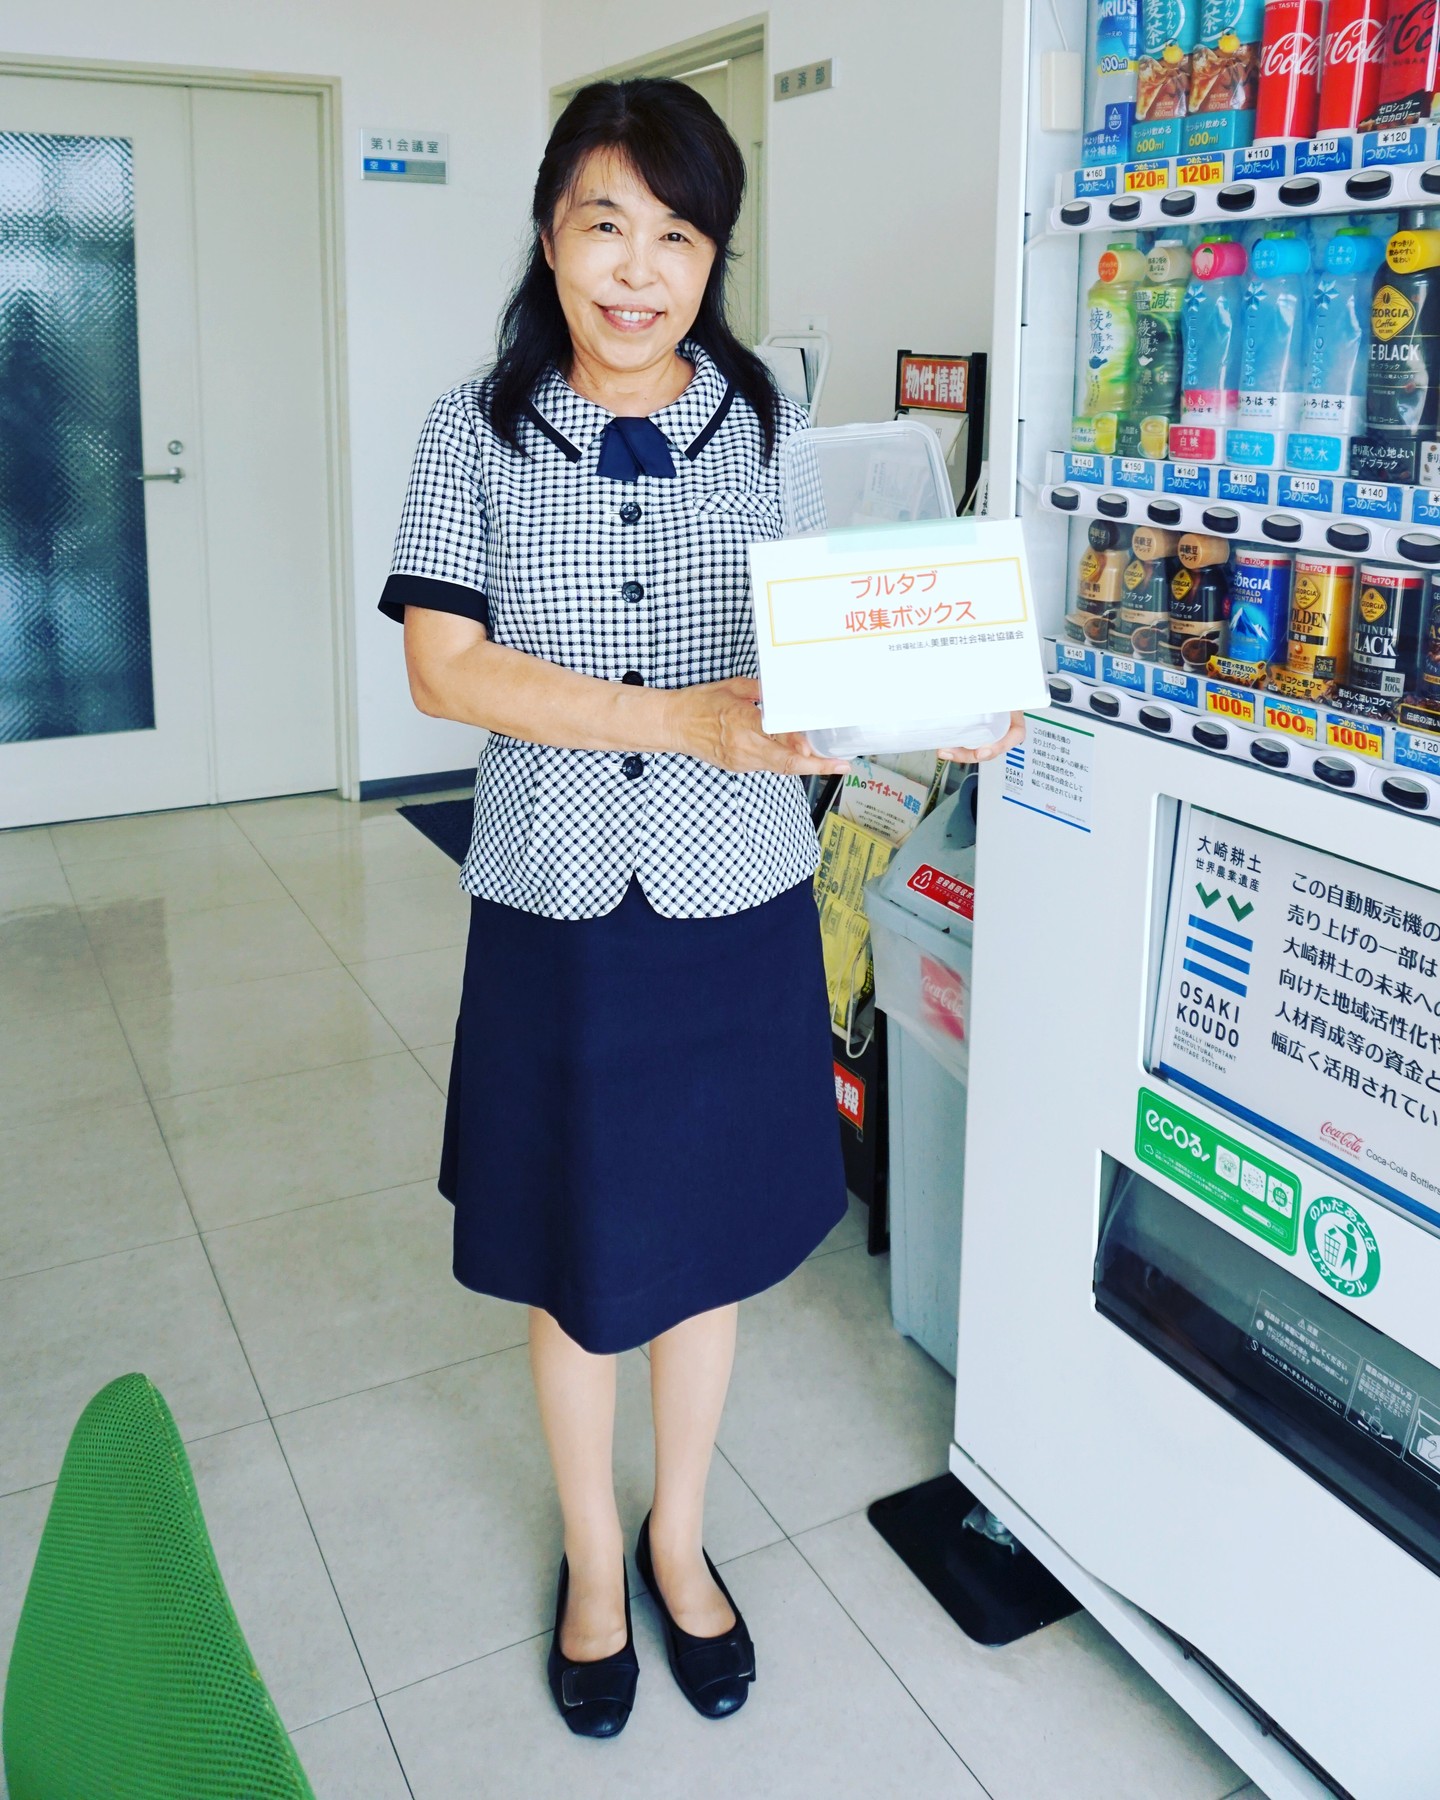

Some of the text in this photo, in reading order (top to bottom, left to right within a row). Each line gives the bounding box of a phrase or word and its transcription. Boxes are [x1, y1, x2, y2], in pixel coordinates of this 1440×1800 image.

[370, 137, 439, 154] 第1会議室
[1136, 138, 1165, 153] 600ml
[1188, 131, 1219, 147] 600ml
[1382, 132, 1407, 142] ¥120
[1247, 150, 1270, 159] ¥110
[1312, 141, 1335, 152] ¥110
[1085, 169, 1103, 178] ¥160
[1128, 170, 1165, 189] 120円
[1180, 163, 1220, 184] 120円
[1090, 307, 1105, 355] 綾鷹
[1379, 343, 1421, 361] BLACK
[904, 364, 966, 404] 物件情報
[1180, 436, 1199, 448] 白桃
[1230, 440, 1264, 457] 天然水
[1074, 457, 1092, 467] ¥140
[1292, 444, 1329, 462] 天然水
[1124, 462, 1142, 472] ¥150
[1176, 467, 1196, 476] ¥140
[1233, 473, 1254, 483] ¥110
[1294, 480, 1316, 490] ¥110
[1360, 487, 1384, 498] ¥140
[849, 569, 940, 599] プルタブ
[1172, 601, 1202, 613] ブラック
[844, 600, 977, 633] 収集ボックス
[1066, 649, 1083, 658] ¥140
[1115, 661, 1132, 671] ¥130
[1209, 693, 1252, 719] 100円
[1267, 708, 1314, 736] 100円
[1330, 725, 1379, 753] 100円
[1414, 739, 1439, 753] ¥120
[1005, 767, 1024, 779] OSAKI
[1005, 775, 1024, 787] KOUDO
[1197, 835, 1262, 874] 大崎耕土
[1195, 857, 1260, 893] 世界農業遺産
[1292, 872, 1440, 942] この自動販売機の
[1287, 904, 1438, 978] 売り上げの一部は
[1180, 980, 1240, 1024] OSAKI
[1176, 1002, 1240, 1048] KOUDO
[1173, 1034, 1215, 1060] AGRICULTURAL
[1174, 1026, 1237, 1062] GLOBALLY IMPORTANT
[1172, 1041, 1227, 1074] HERITAGE SYSTEMS
[1271, 1031, 1439, 1127] 幅広く活用されてい
[1365, 1148, 1408, 1178] Coca-Cola
[1309, 1199, 1377, 1254] のんだあとは
[1310, 1248, 1367, 1296] リサイクル
